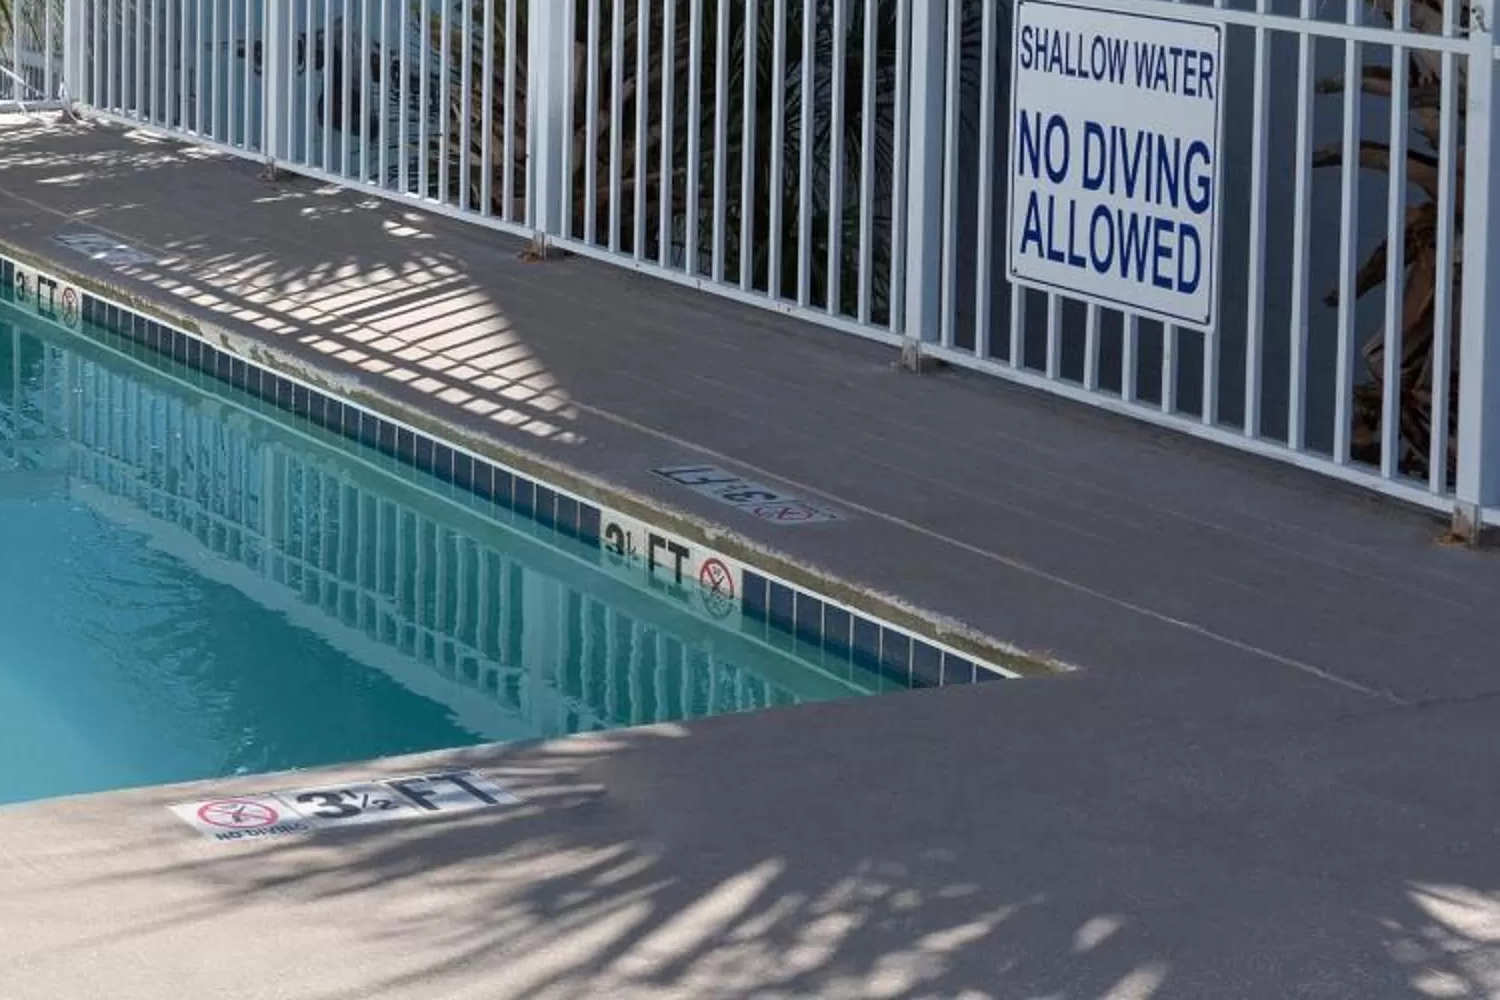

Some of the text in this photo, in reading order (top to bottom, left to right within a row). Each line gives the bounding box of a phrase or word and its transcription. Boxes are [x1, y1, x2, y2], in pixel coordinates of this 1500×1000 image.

[1020, 24, 1214, 100] SHALLOW WATER
[1018, 109, 1212, 215] NO DIVING
[1019, 190, 1202, 296] ALLOWED
[386, 769, 500, 810] FT
